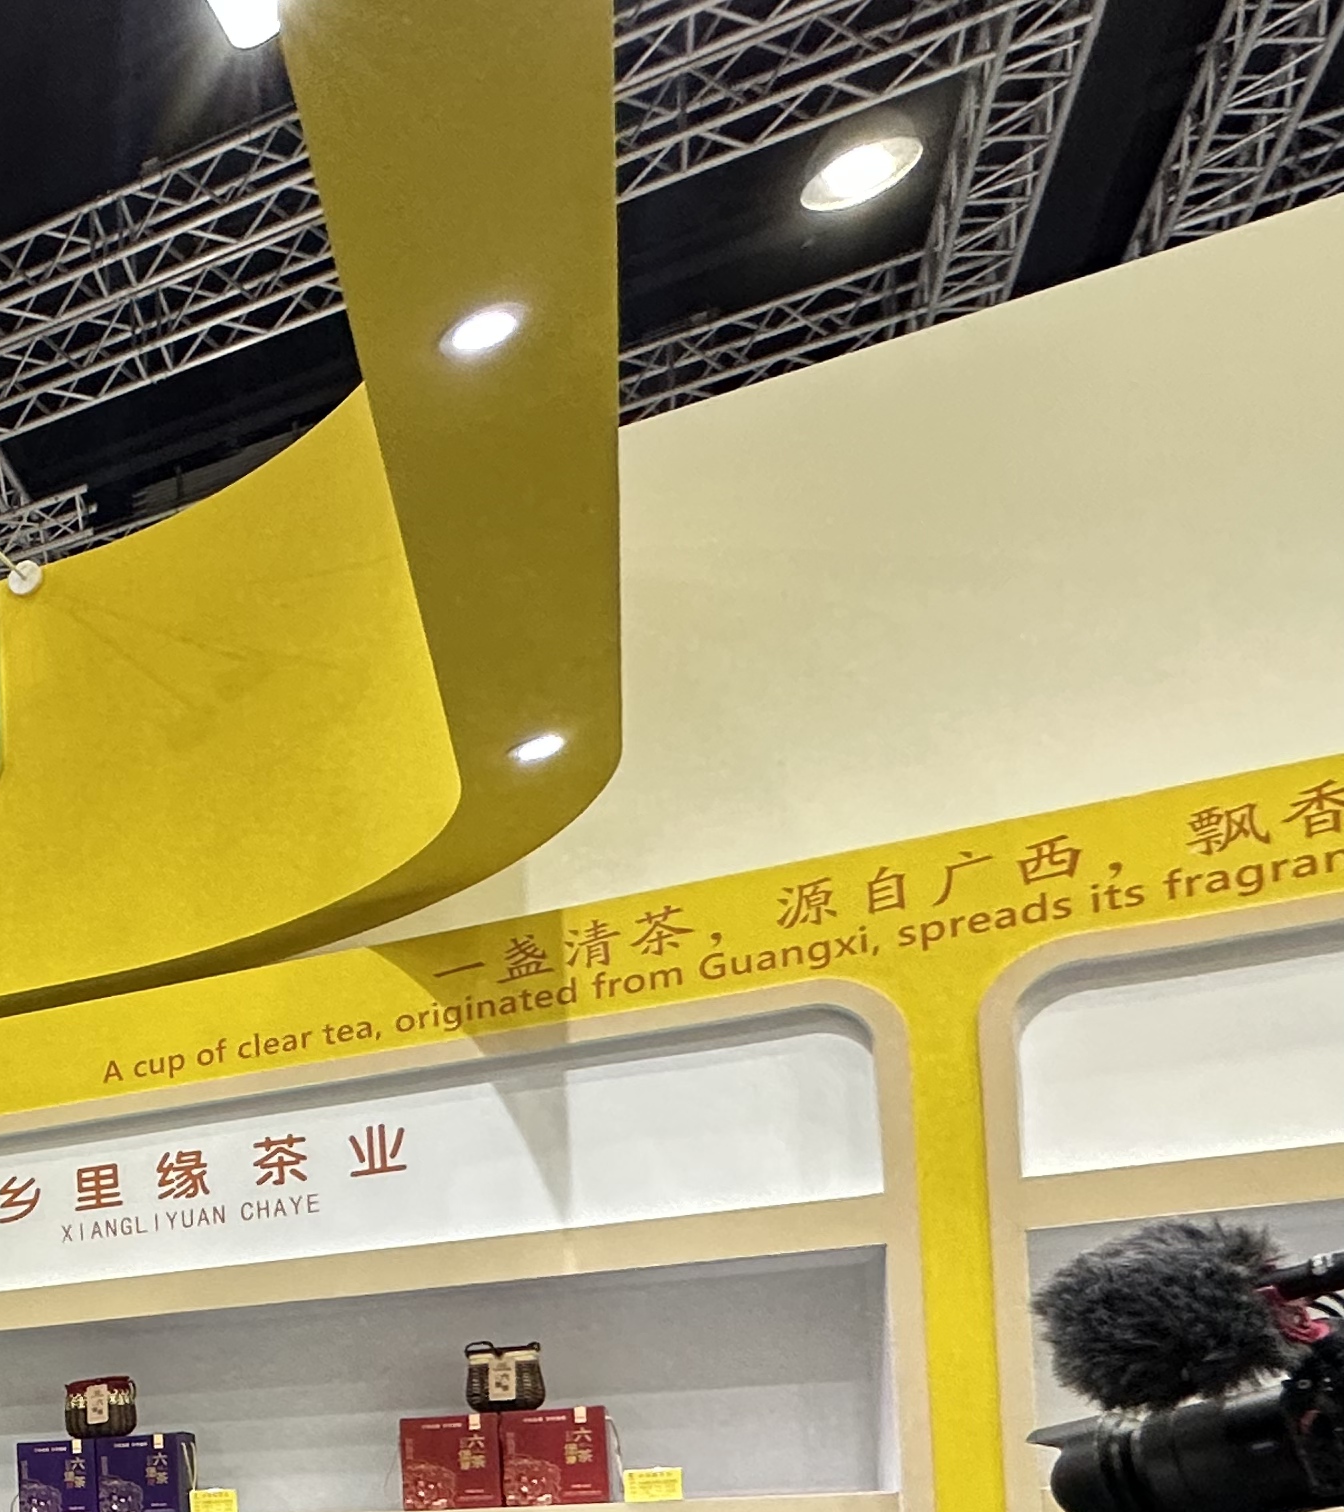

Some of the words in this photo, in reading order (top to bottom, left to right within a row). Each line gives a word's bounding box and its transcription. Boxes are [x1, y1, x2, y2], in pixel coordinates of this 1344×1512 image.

[102, 1059, 124, 1084] A
[134, 1051, 186, 1080] cup
[197, 1039, 227, 1067] of
[237, 1028, 310, 1060] clear
[323, 1017, 381, 1044] tea,
[395, 977, 577, 1032] originated
[595, 966, 683, 1000] from
[699, 925, 880, 980] Guangxi,
[898, 892, 1072, 950] spreads
[1091, 883, 1145, 914] its
[61, 1204, 226, 1243] XIANGLIYUAN
[240, 1193, 321, 1222] CHAYE
